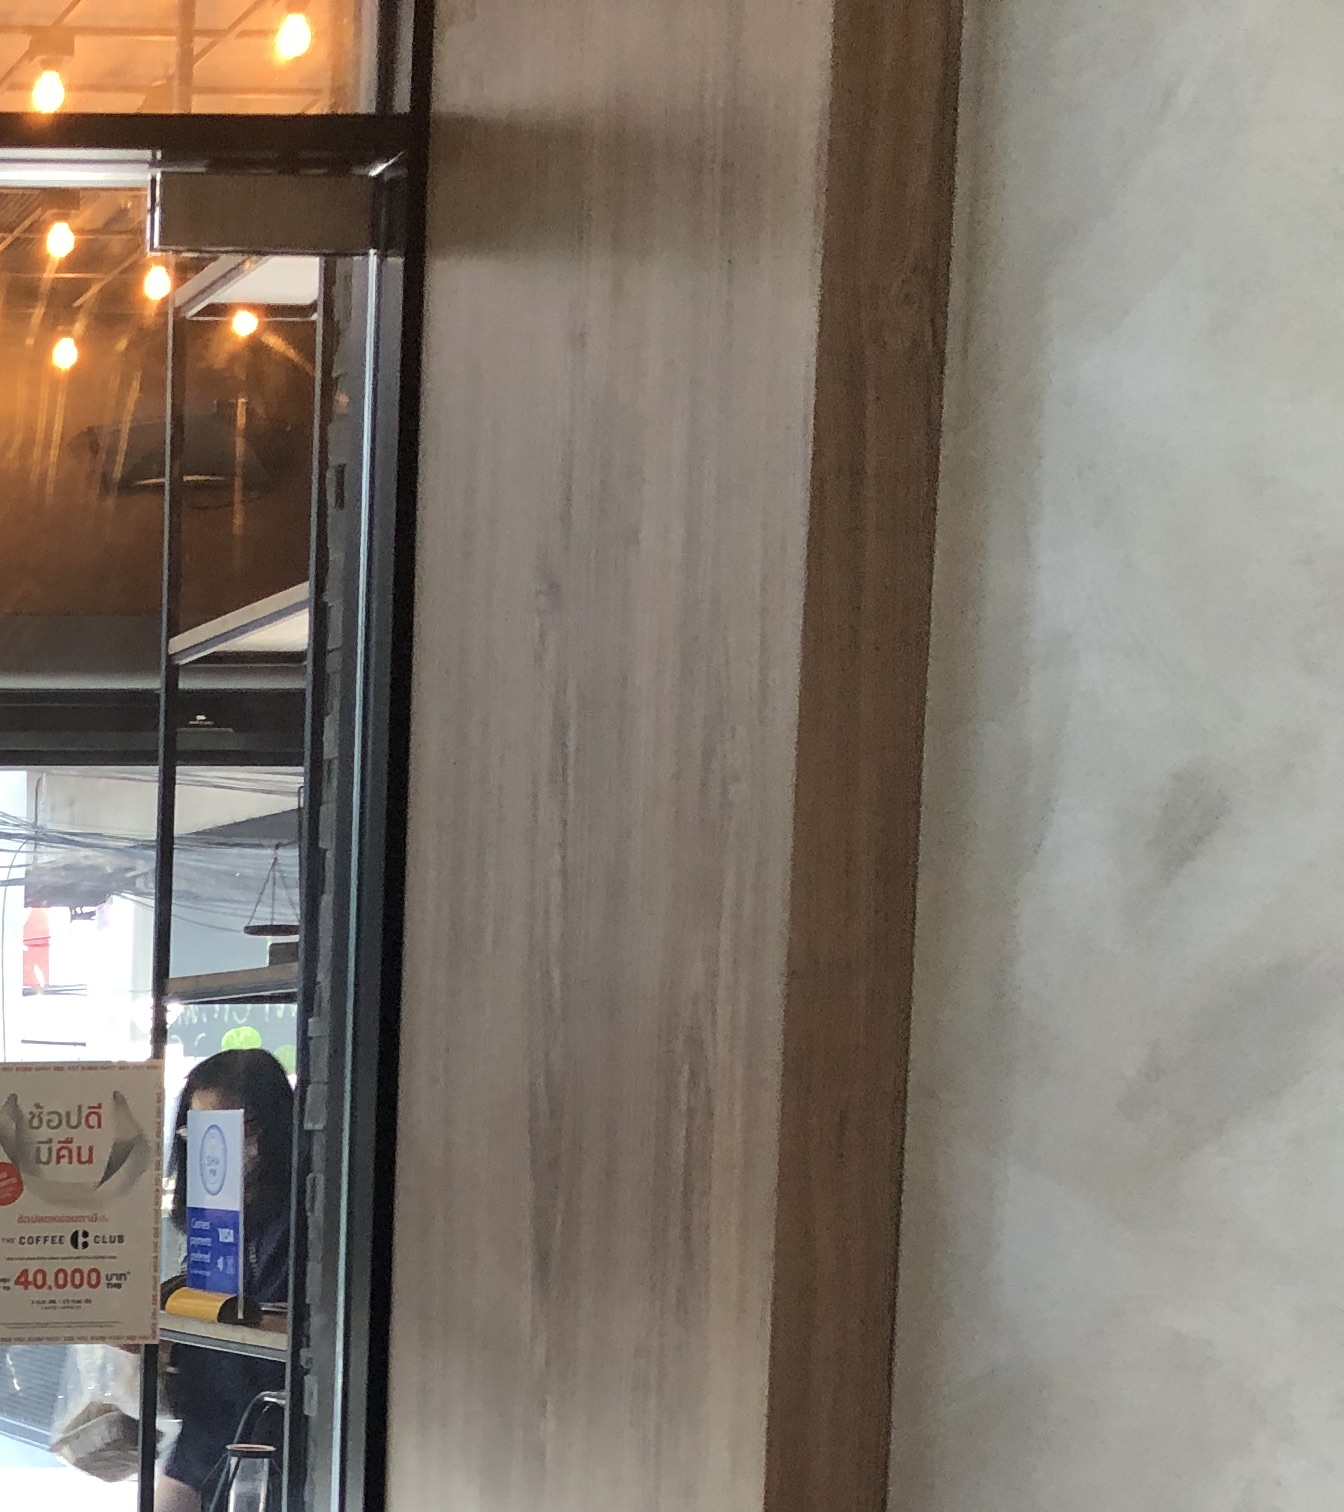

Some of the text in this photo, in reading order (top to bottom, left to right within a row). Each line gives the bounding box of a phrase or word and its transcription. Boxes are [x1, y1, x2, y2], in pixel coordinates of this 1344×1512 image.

[28, 1102, 103, 1130] ช้อปดี
[34, 1136, 94, 1166] มีคืน
[18, 1235, 65, 1246] COFFEE
[93, 1234, 125, 1244] CLUB
